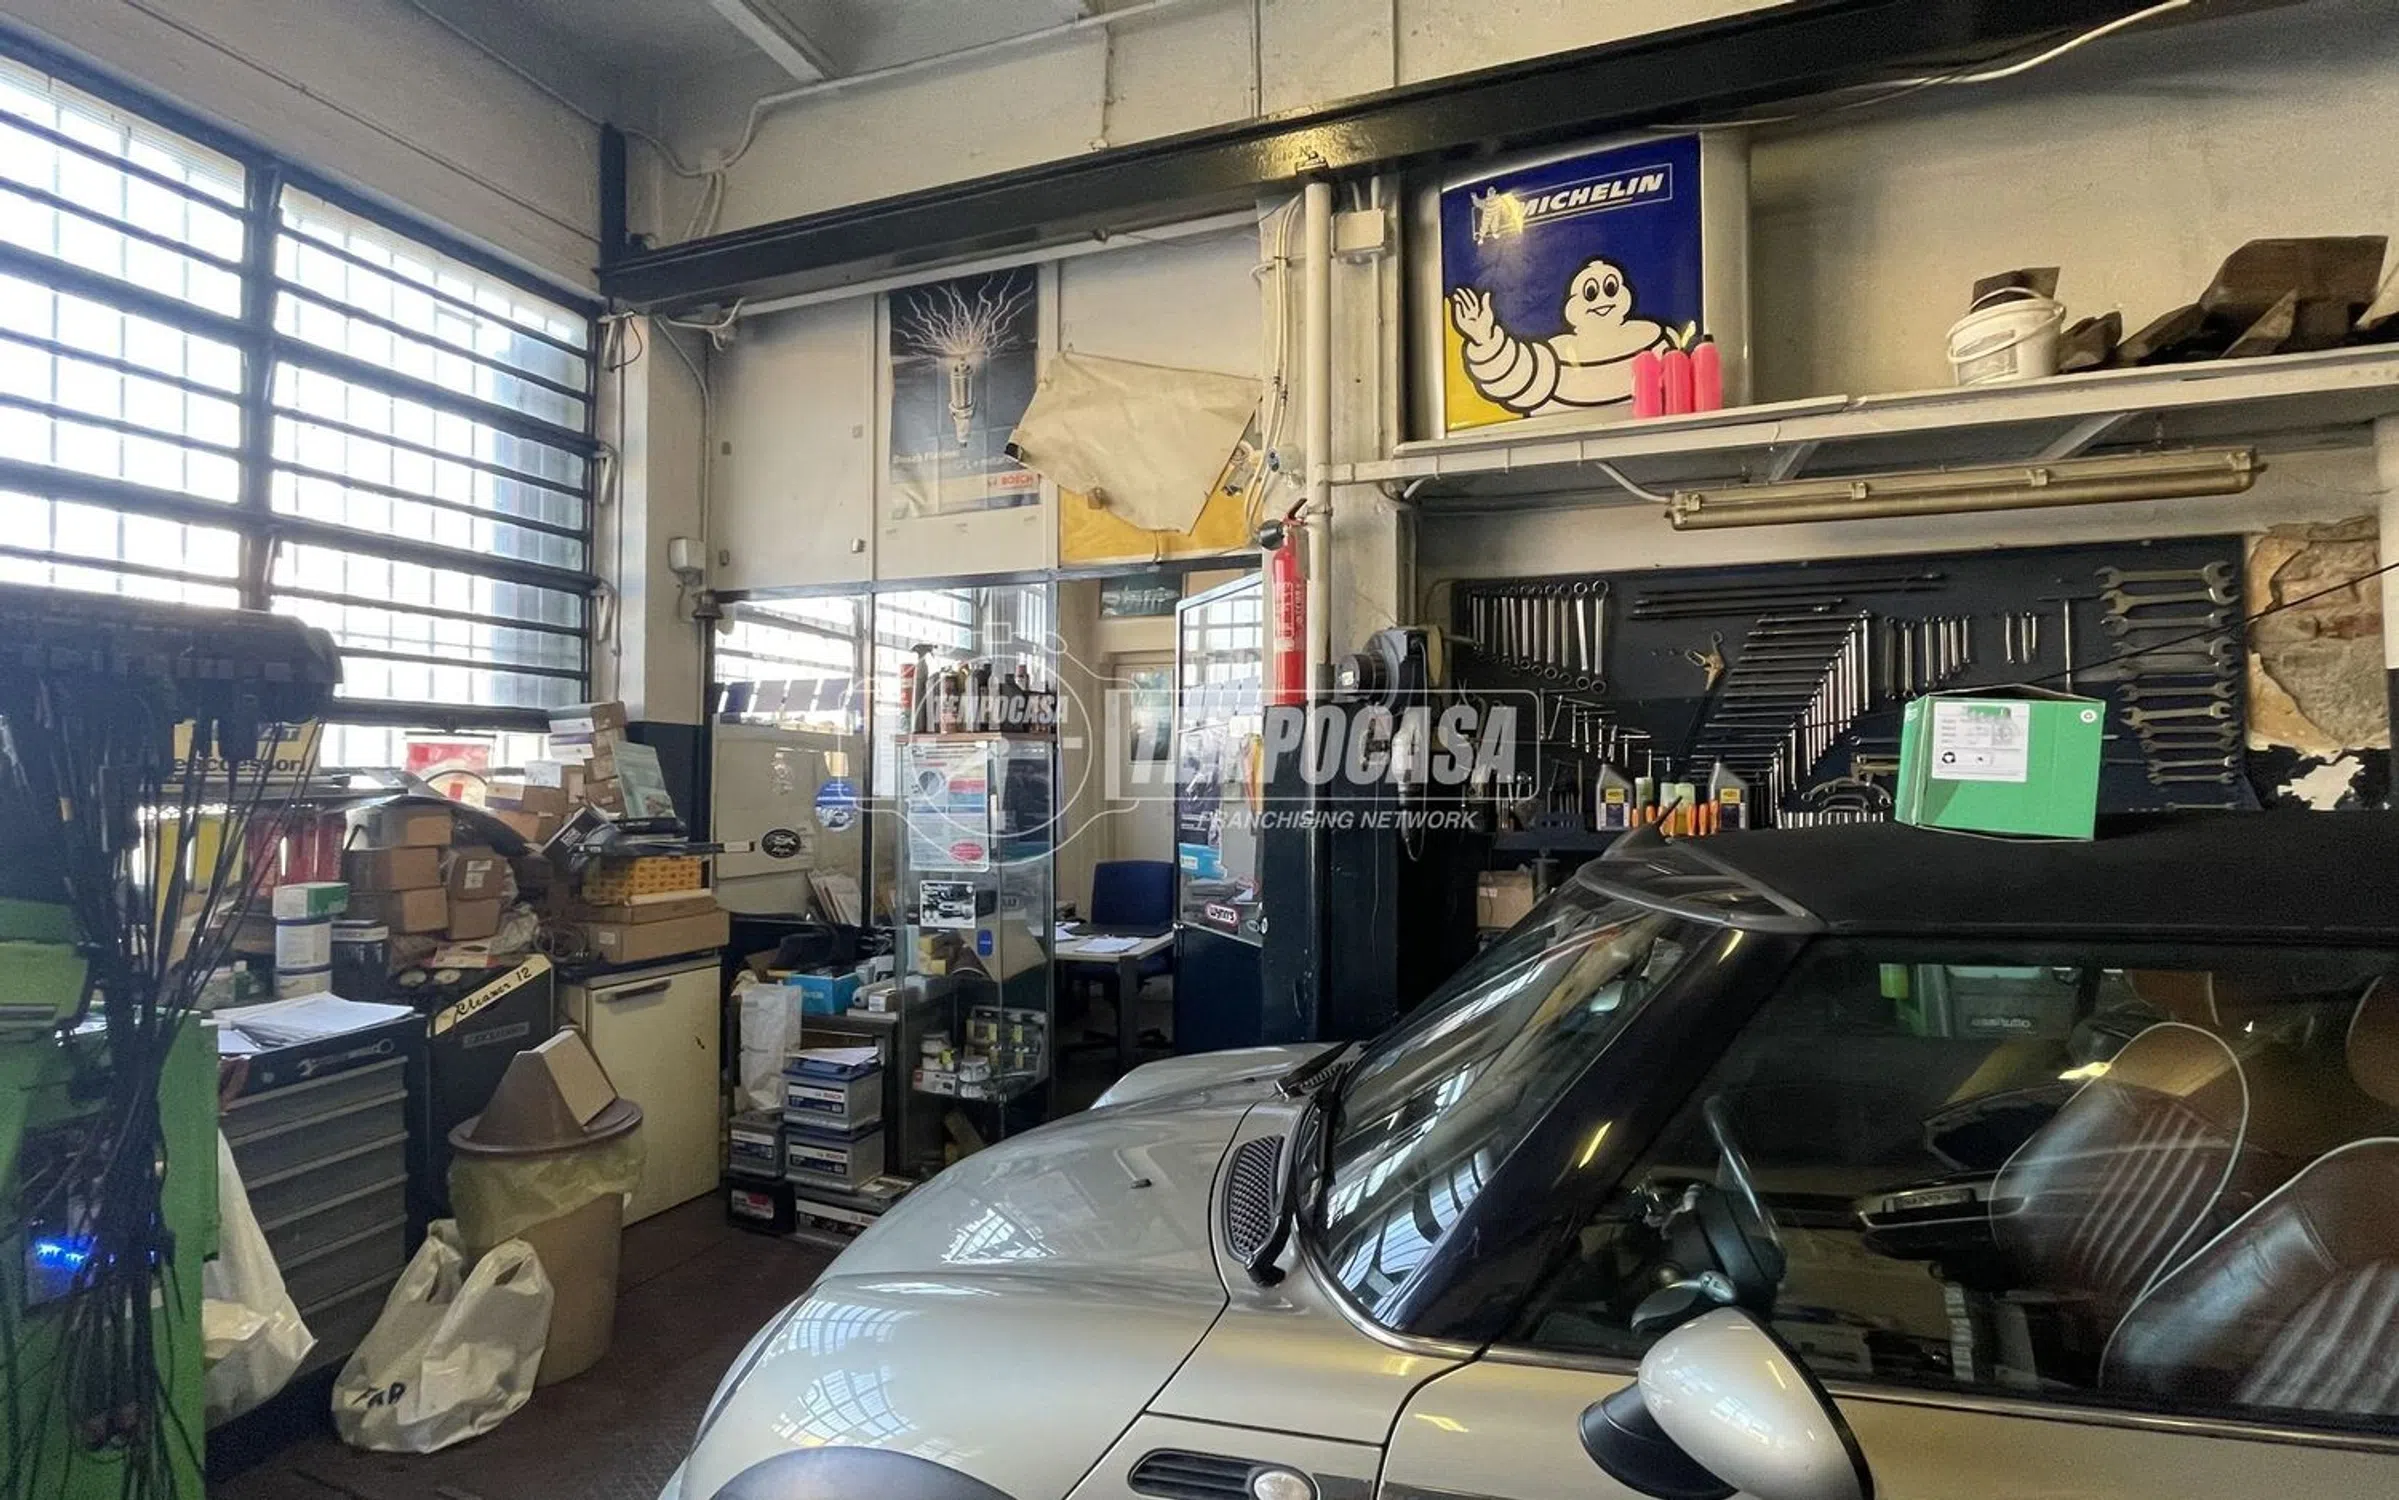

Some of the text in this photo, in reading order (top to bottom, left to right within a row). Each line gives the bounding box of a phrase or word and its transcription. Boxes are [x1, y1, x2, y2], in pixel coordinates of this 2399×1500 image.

[1521, 173, 1664, 216] MICHELIN
[1001, 474, 1033, 486] BOSCH
[516, 967, 532, 981] 12
